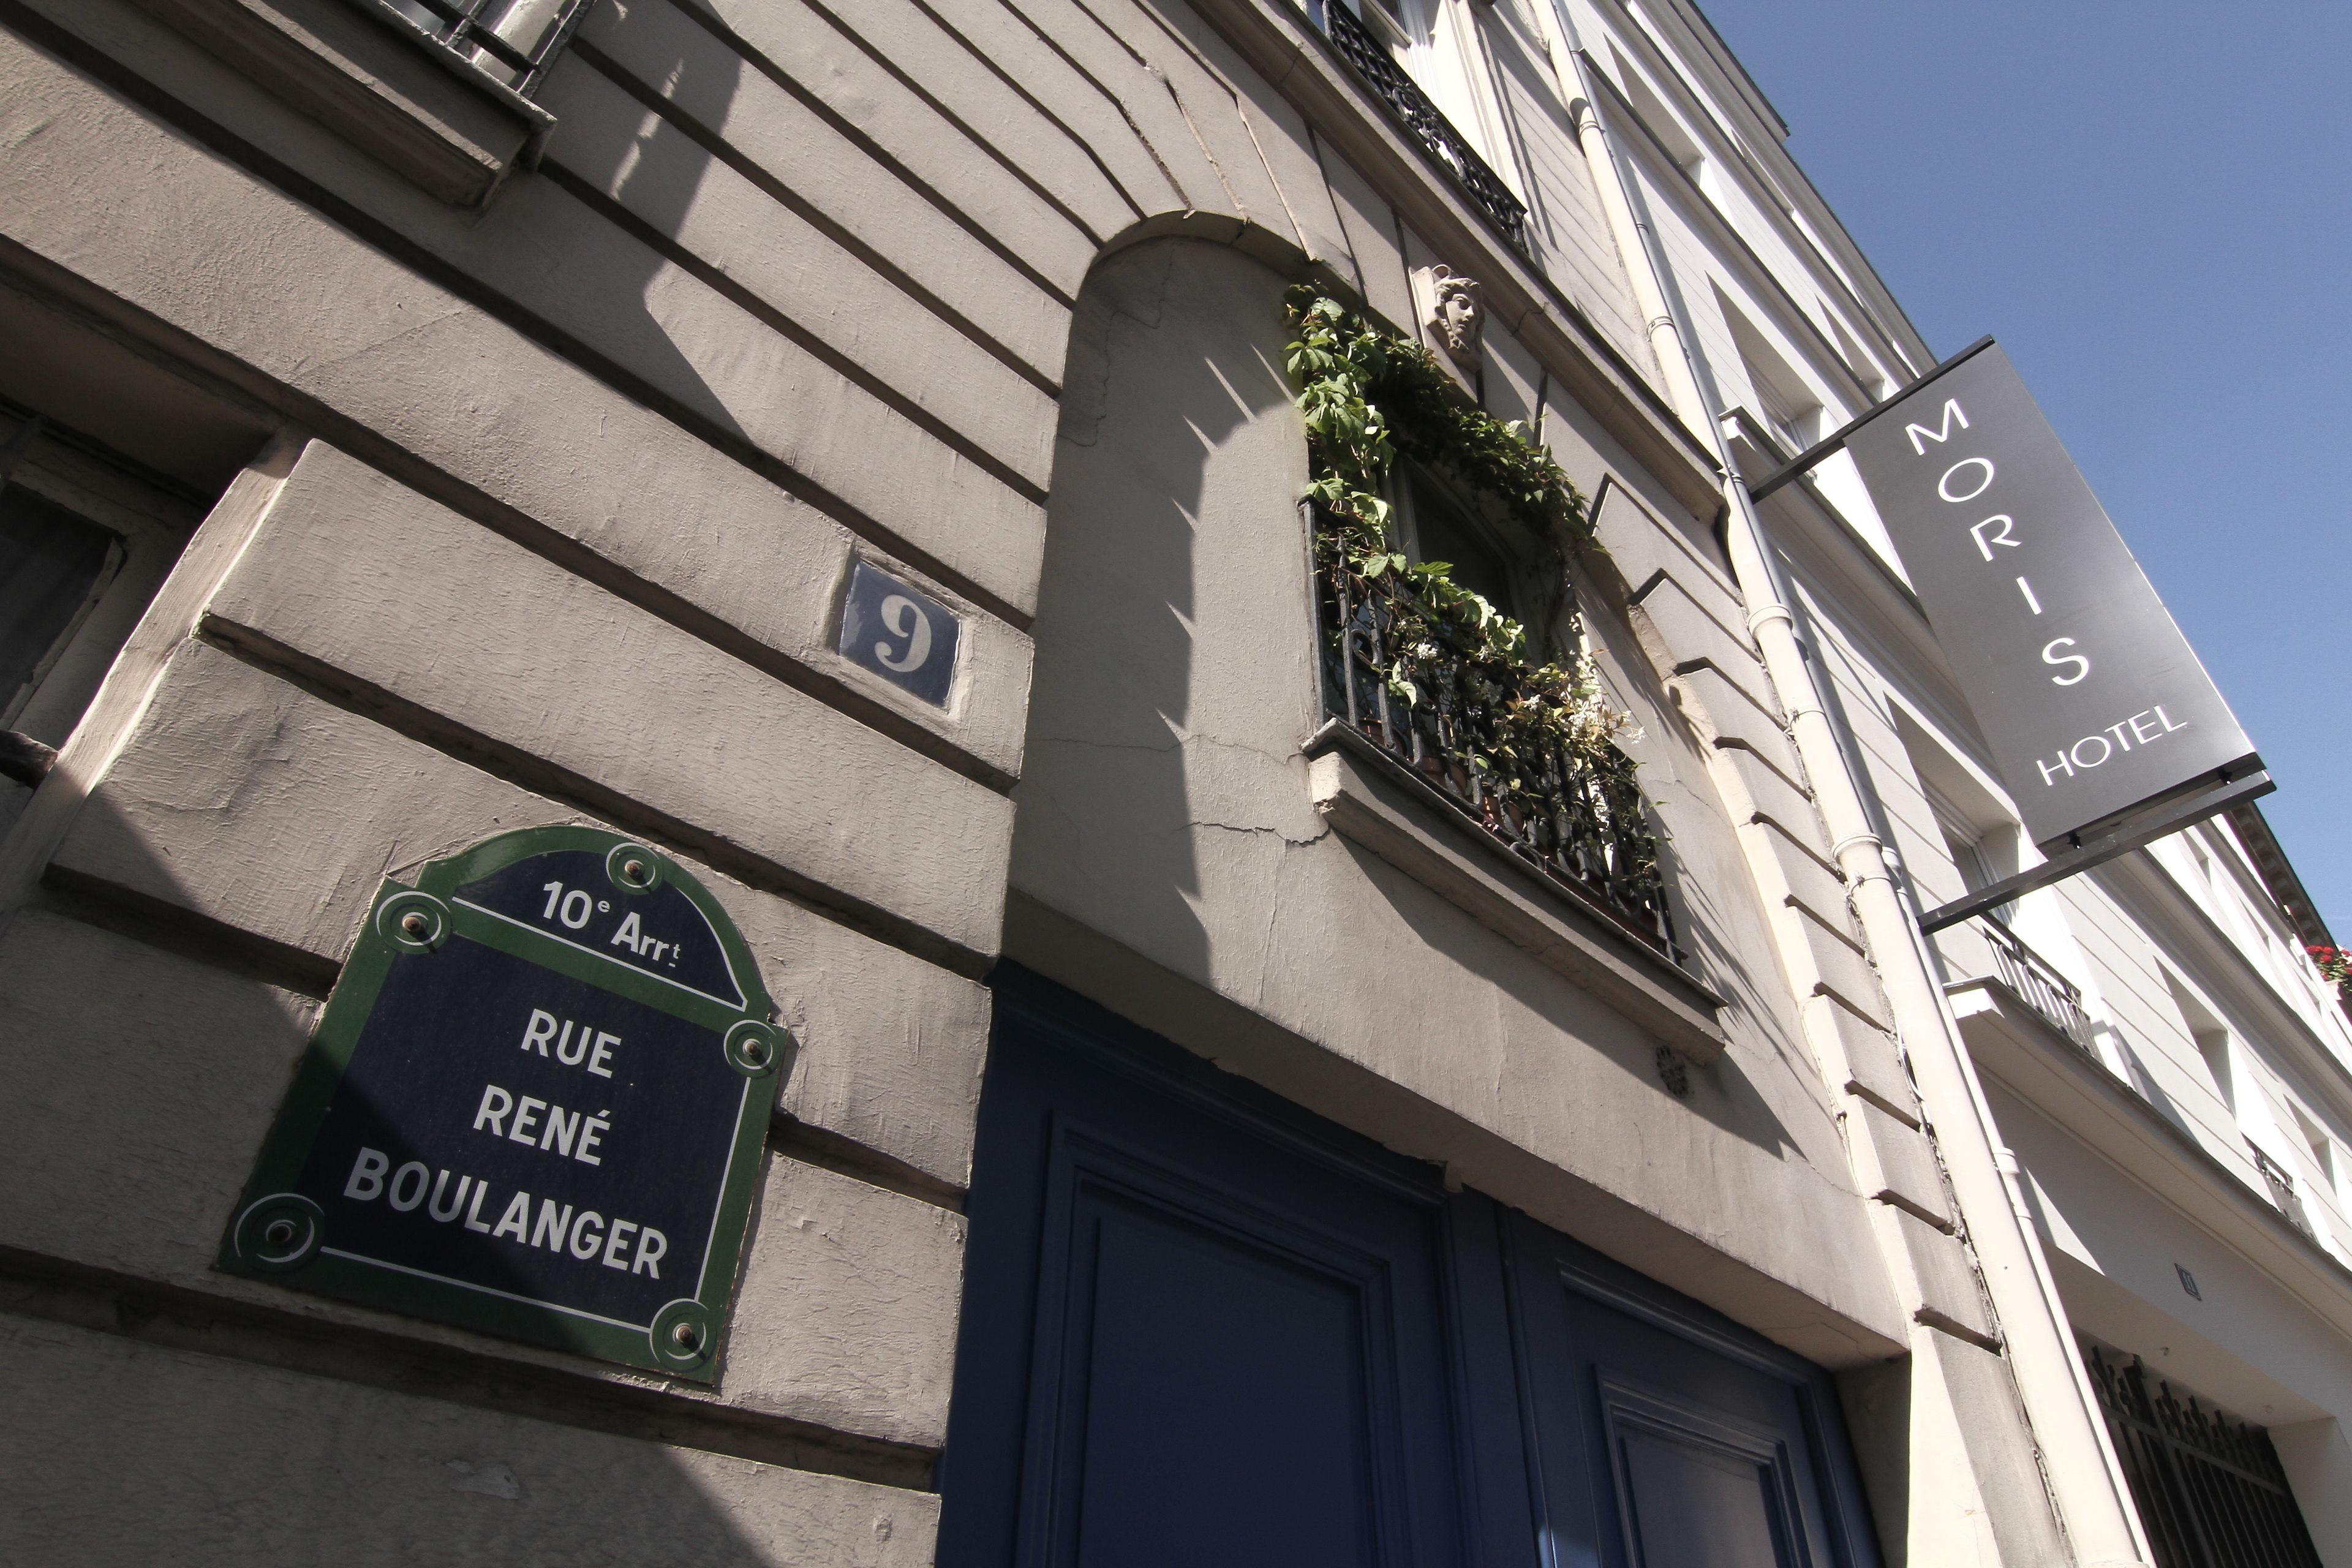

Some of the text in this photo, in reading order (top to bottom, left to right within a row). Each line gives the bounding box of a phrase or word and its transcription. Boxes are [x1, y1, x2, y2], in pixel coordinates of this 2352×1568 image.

[1905, 398, 2090, 686] MORIS
[875, 595, 931, 672] 9
[2037, 705, 2187, 786] HOTEL
[521, 1009, 621, 1078] RUE
[473, 1085, 611, 1166] RENÉ
[343, 1147, 668, 1280] BOULANGER
